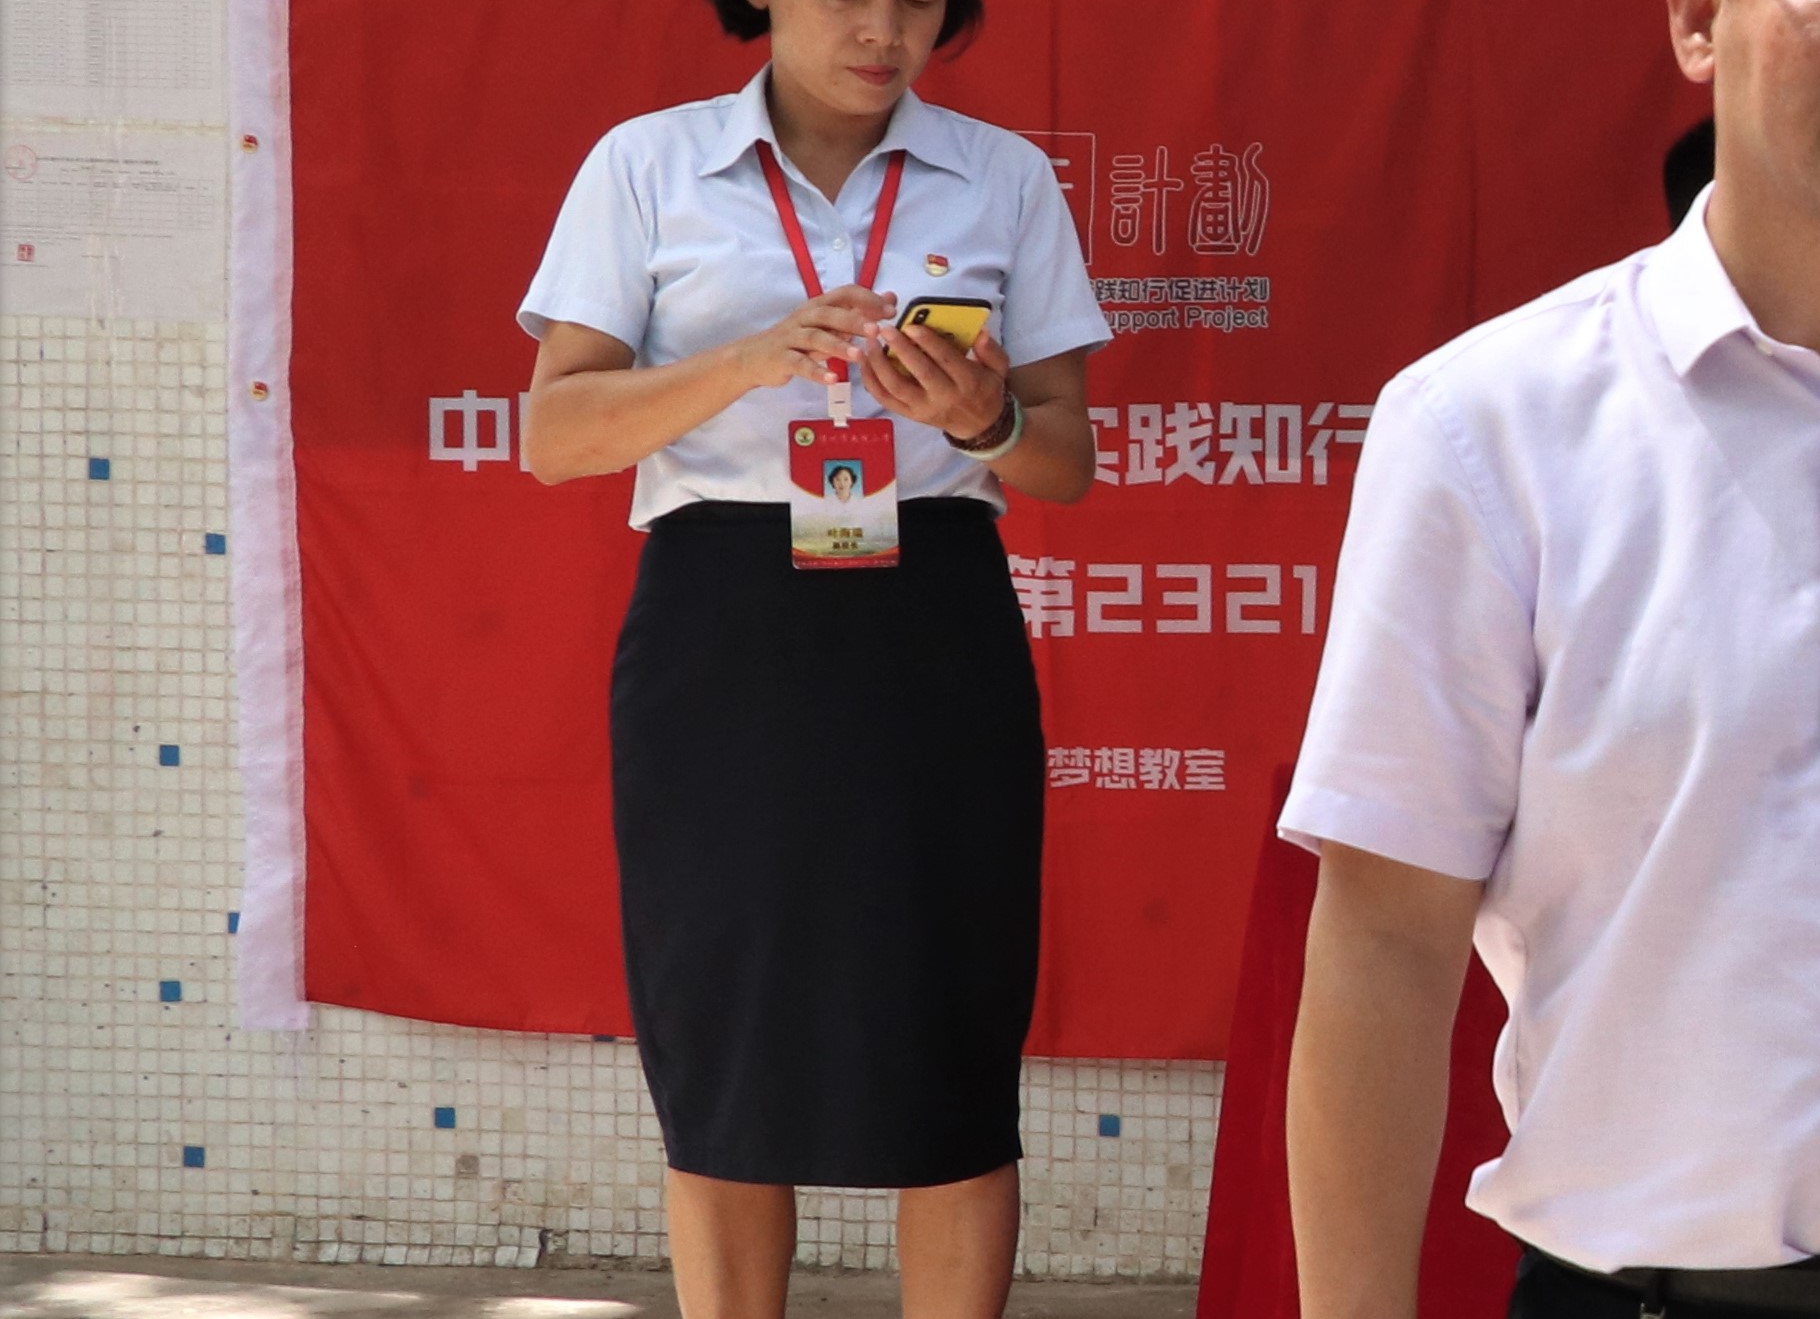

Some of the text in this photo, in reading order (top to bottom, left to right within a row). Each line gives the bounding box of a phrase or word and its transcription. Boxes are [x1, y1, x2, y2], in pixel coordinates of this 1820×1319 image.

[1090, 277, 1270, 302] 践知行促进计划
[1102, 307, 1268, 332] upport Project
